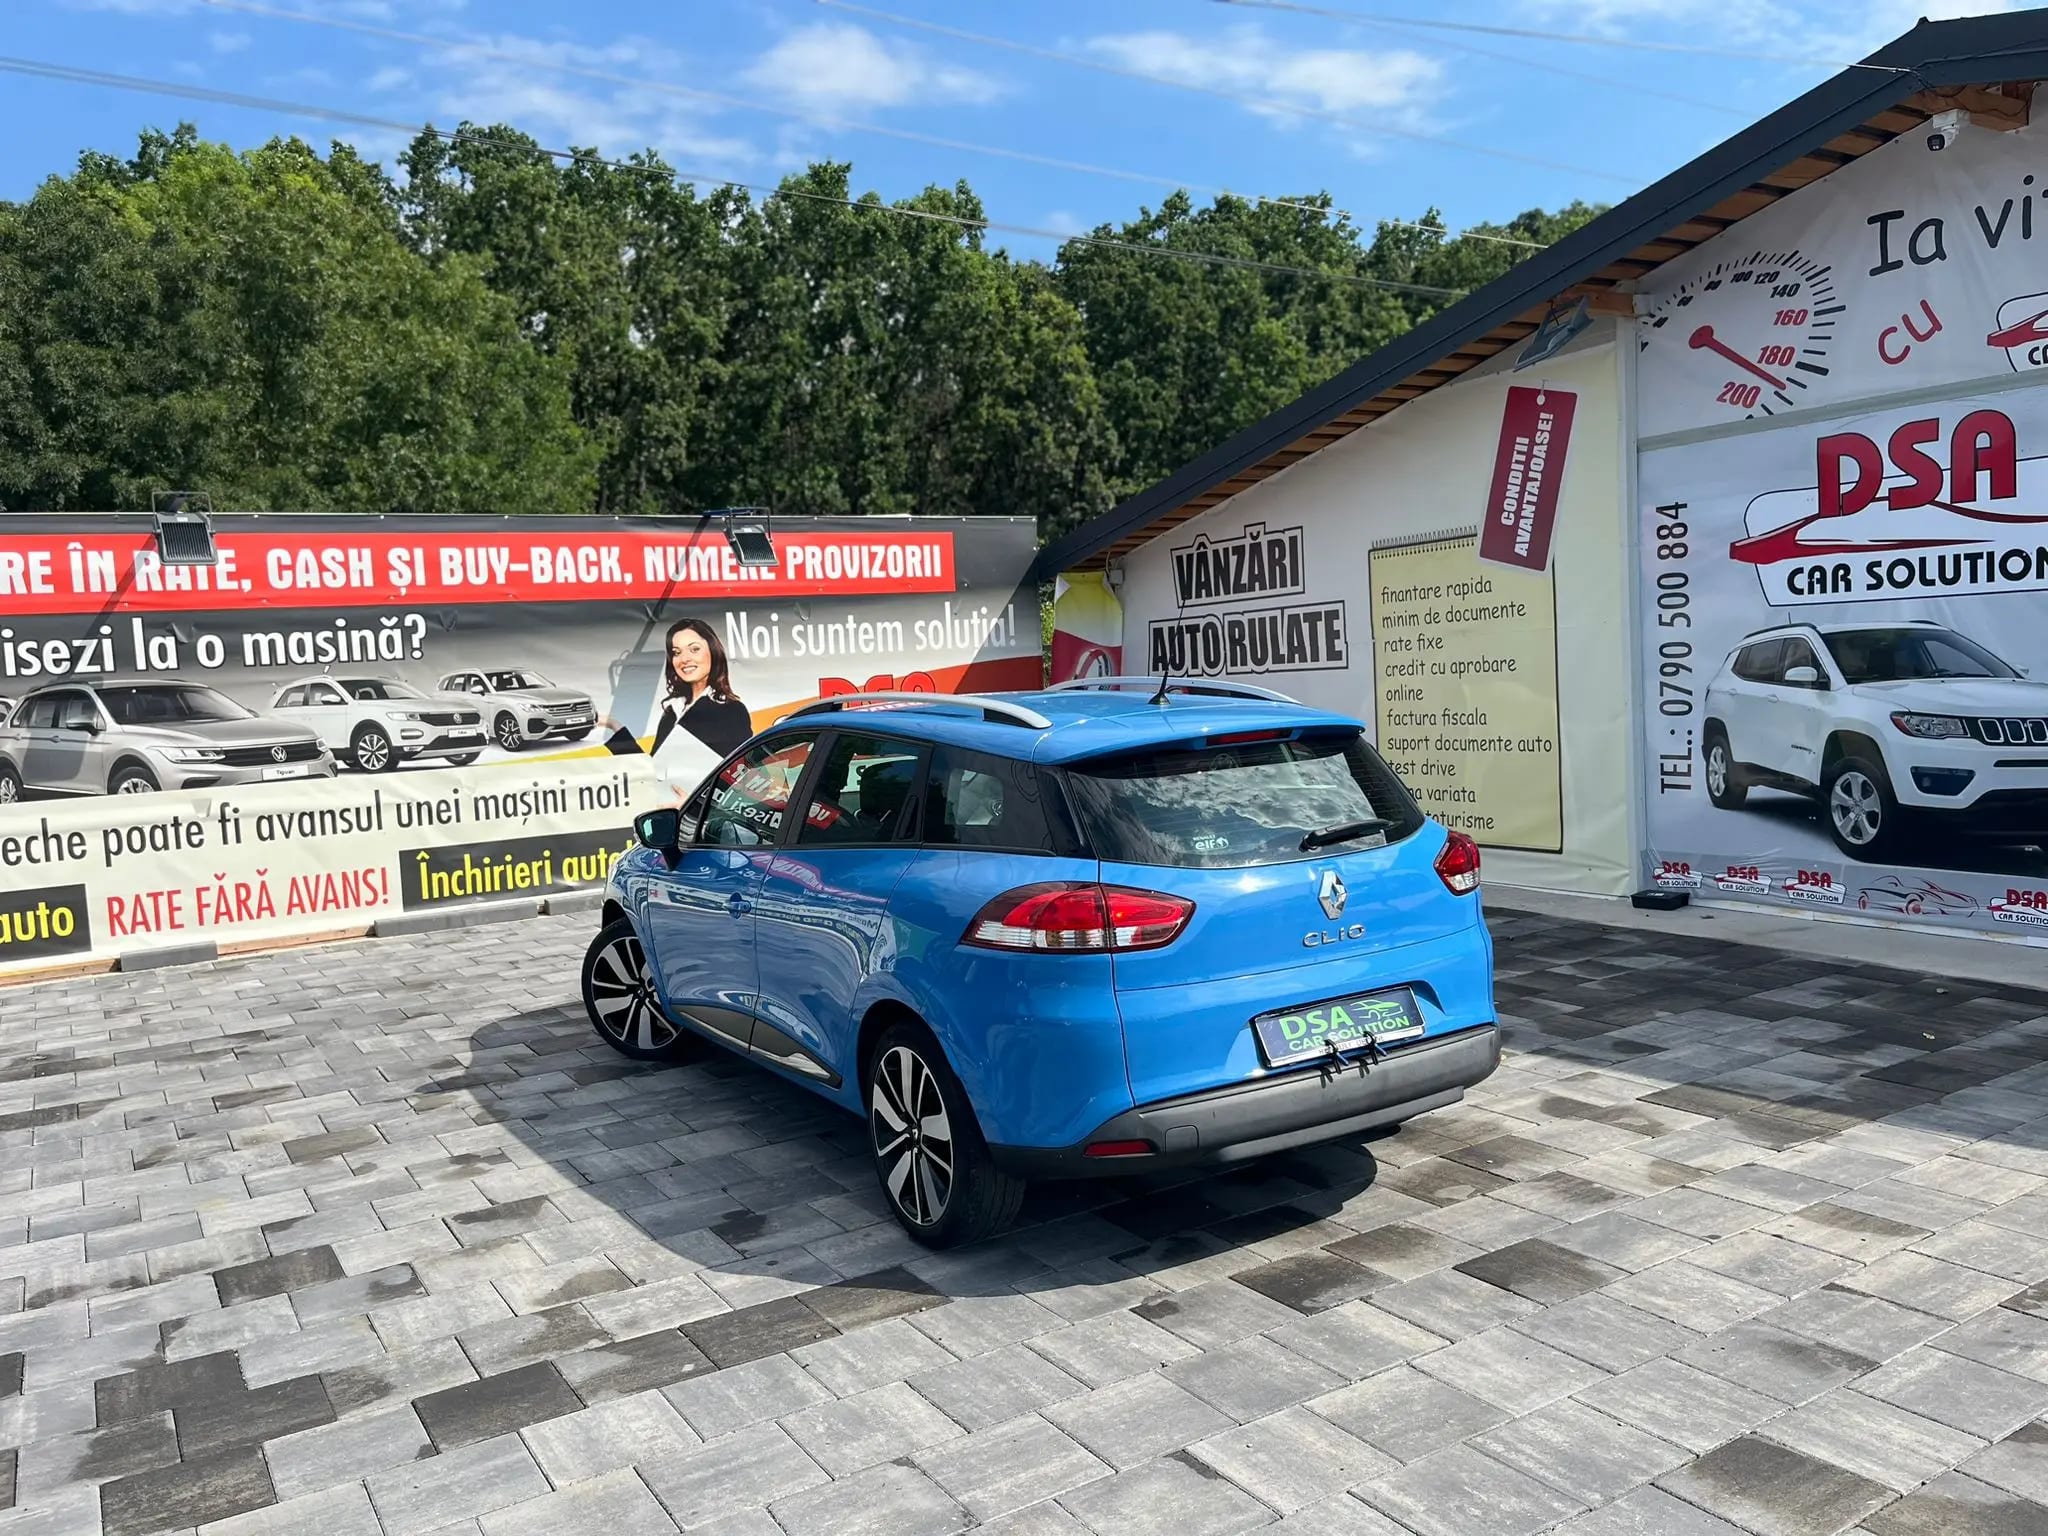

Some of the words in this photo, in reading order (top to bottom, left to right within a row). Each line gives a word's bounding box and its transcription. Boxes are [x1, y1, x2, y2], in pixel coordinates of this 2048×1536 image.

[1866, 209, 1947, 277] Ia
[1974, 174, 2048, 249] vi
[1730, 270, 1754, 283] 100
[1754, 270, 1781, 285] 120
[1770, 283, 1801, 299] 140
[1773, 309, 1809, 326] 160
[1878, 299, 1944, 366] cu
[1757, 345, 1796, 367] 180
[1716, 381, 1762, 409] 200
[1816, 409, 2017, 520] DSA
[1501, 436, 1530, 526] CONDITII
[1514, 412, 1554, 557] AVANTAJOASE!
[1655, 500, 1689, 561] 884
[67, 542, 117, 593] ÎN
[266, 547, 375, 589] CASH
[388, 547, 426, 596] ȘI
[439, 545, 633, 588] BUY-BACK,
[786, 544, 942, 581] PROVIZORII
[1176, 530, 1300, 600] VÂNZĂRI
[1381, 583, 1442, 604] finantare
[1446, 575, 1493, 601] rapida
[1786, 562, 1853, 596] CAR
[1657, 571, 1692, 629] 500
[1382, 610, 1420, 629] minim
[1424, 607, 1441, 625] de
[1445, 600, 1527, 623] documente
[131, 617, 179, 671] la
[195, 634, 226, 668] o
[242, 613, 427, 674] mașină?
[725, 611, 781, 659] Noi
[792, 613, 900, 656] suntem
[1152, 620, 1224, 672] AUTO
[1227, 609, 1344, 668] RULATE
[1384, 636, 1413, 653] rate
[1417, 633, 1444, 651] fixe
[1385, 659, 1426, 677] credit
[1431, 662, 1446, 675] cu
[1450, 655, 1517, 679] aprobare
[1659, 641, 1693, 717] 0790
[1386, 684, 1424, 702] online
[1386, 708, 1437, 727] factura
[1441, 707, 1487, 727] fiscala
[1387, 735, 1430, 754] suport
[1435, 733, 1513, 753] documente
[1517, 735, 1552, 753] auto
[1389, 759, 1416, 775] test
[1421, 758, 1456, 776] drive
[1426, 785, 1476, 803] variata
[2, 818, 87, 866] eche
[102, 816, 205, 867] poate
[218, 802, 242, 845] fi
[256, 789, 383, 840] avansul
[396, 788, 461, 828] unei
[473, 779, 567, 826] mașini
[578, 772, 631, 811] noi!
[1195, 839, 1216, 850] elf
[415, 850, 553, 900] Închirieri
[1661, 861, 1690, 875] DSA
[1726, 866, 1759, 881] DSA
[1797, 869, 1832, 888] DSA
[1671, 880, 1698, 888] SOLUTION
[1735, 884, 1765, 893] SOLUTION
[1792, 891, 1804, 899] CAR
[1806, 892, 1839, 903] SOLUTION
[107, 889, 185, 938] RATE
[195, 868, 276, 927] FĂRĂ
[287, 867, 389, 916] AVANS!
[2006, 889, 2048, 909] DSA
[1998, 913, 2013, 921] CAR
[1303, 924, 1365, 948] CLIO
[1279, 1005, 1354, 1041] DSA
[1289, 1035, 1325, 1051] CAR
[1327, 1015, 1410, 1043] SOLUTION
